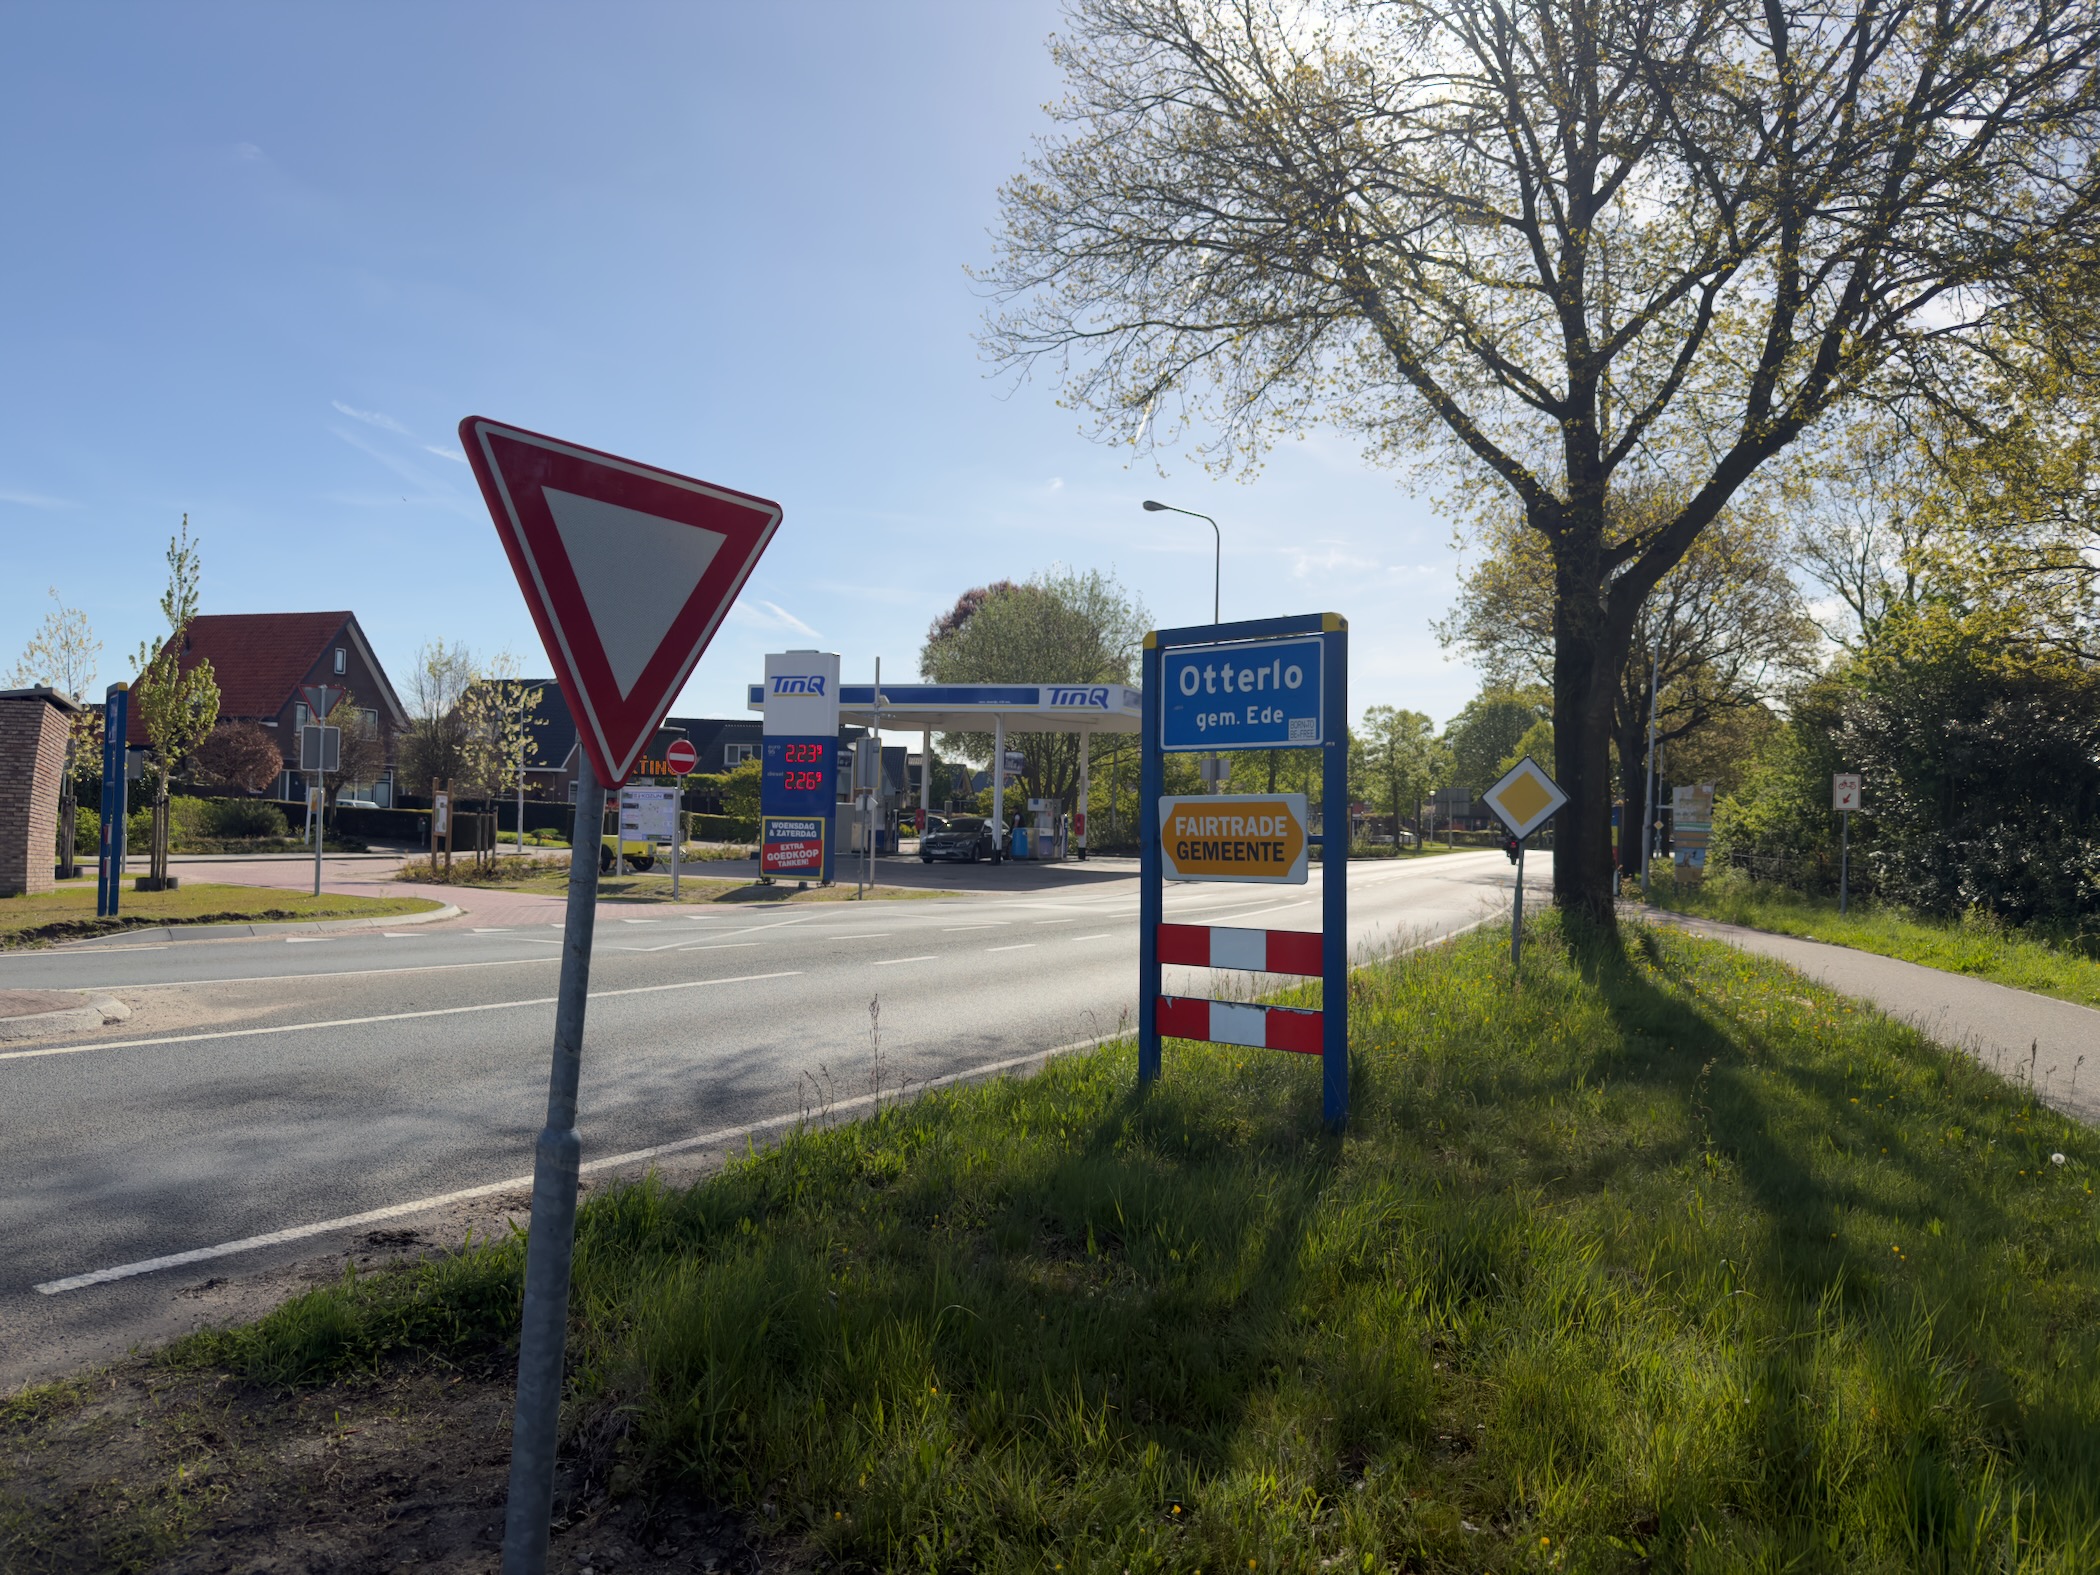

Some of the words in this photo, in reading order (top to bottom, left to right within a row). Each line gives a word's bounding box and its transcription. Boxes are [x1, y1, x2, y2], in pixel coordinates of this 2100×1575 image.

[770, 675, 825, 696] TinQ
[1179, 658, 1303, 696] Otterlo
[1046, 687, 1109, 709] TinQ
[1196, 711, 1240, 732] gem.
[1247, 706, 1284, 724] Ede
[771, 821, 815, 830] WOENSDAG
[776, 829, 817, 838] ZATERDAG
[1175, 816, 1288, 837] FAIRTRADE
[767, 849, 819, 861] GOEDKOOP
[780, 843, 804, 851] EXTRA
[1176, 841, 1285, 862] GEMEENTE
[778, 859, 809, 867] TANKEN!
